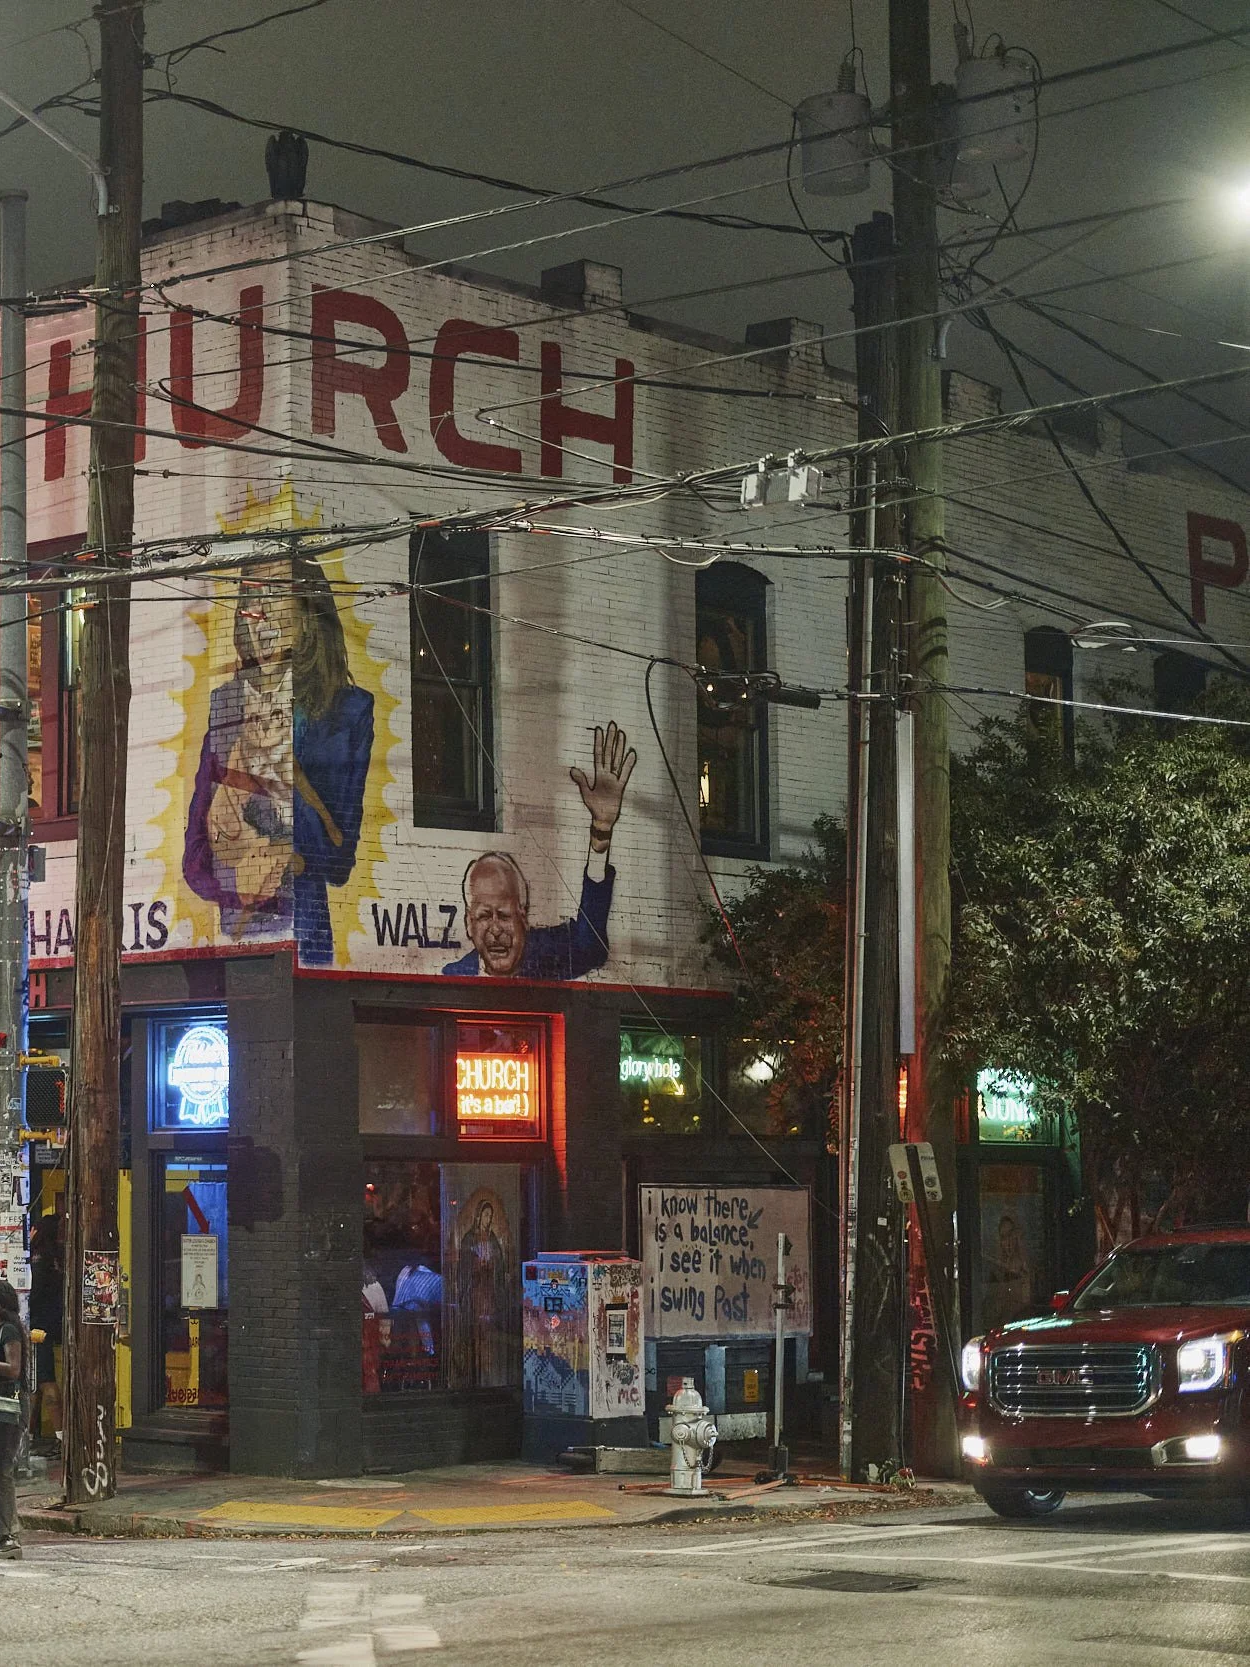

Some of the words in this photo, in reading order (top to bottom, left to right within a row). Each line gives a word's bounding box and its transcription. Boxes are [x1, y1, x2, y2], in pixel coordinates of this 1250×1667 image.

[29, 901, 168, 955] HAIS
[372, 903, 461, 949] WALZ
[456, 1058, 529, 1091] CHURCH
[619, 1055, 651, 1082] glory
[654, 1057, 681, 1078] hole
[484, 1097, 493, 1113] a
[661, 1190, 697, 1218] know
[704, 1190, 748, 1221] there
[655, 1217, 667, 1242] is
[674, 1222, 683, 1242] a
[670, 1249, 701, 1273] see
[709, 1249, 722, 1275] it
[730, 1250, 766, 1282] when
[660, 1278, 704, 1321] swing
